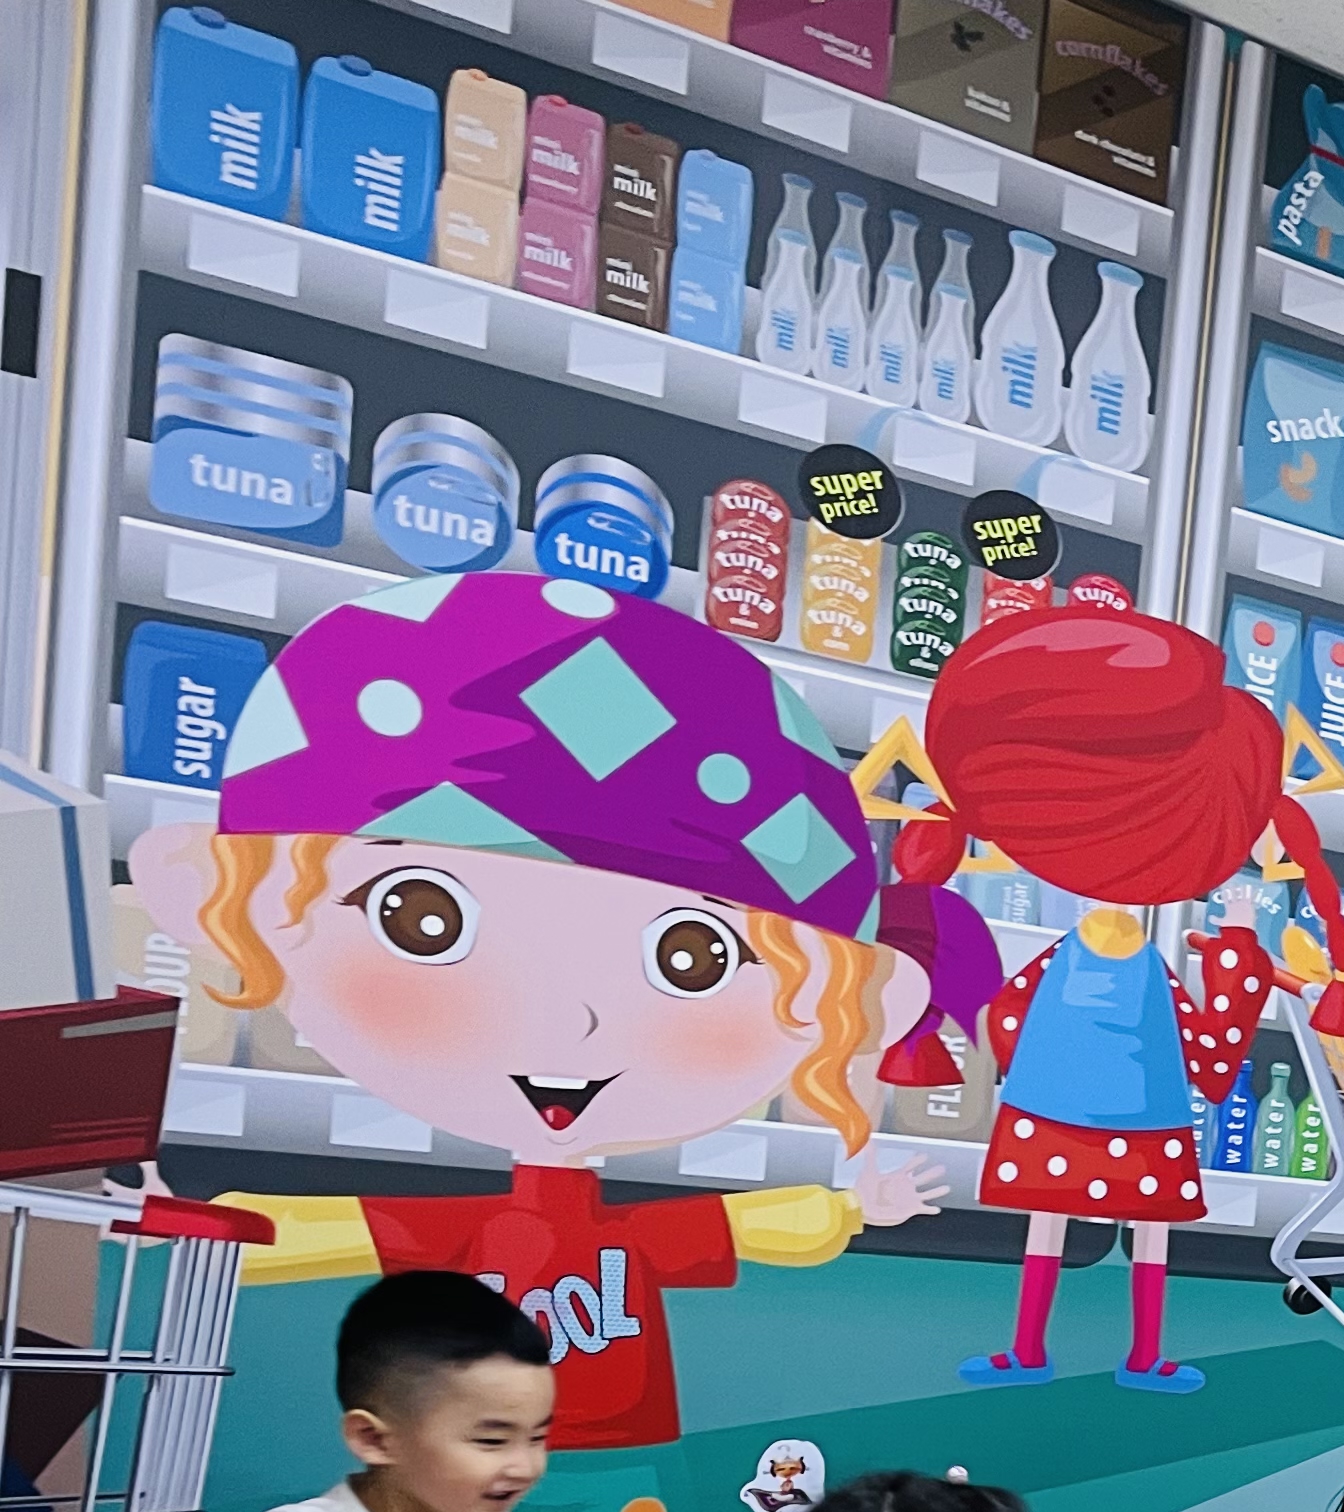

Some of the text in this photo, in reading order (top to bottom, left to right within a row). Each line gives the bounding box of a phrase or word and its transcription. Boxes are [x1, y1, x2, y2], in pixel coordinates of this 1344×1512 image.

[209, 103, 263, 191] milk
[354, 147, 405, 232] milk
[613, 176, 657, 201] milk
[1277, 170, 1325, 246] pasta
[606, 269, 650, 294] milk
[1001, 340, 1038, 409] milk
[1090, 369, 1124, 436] milk
[1266, 407, 1344, 443] snack
[189, 454, 294, 506] tuna
[809, 470, 884, 500] super
[393, 494, 496, 548] tuna
[719, 493, 784, 523] tuna
[819, 493, 879, 524] price!
[973, 515, 1042, 543] super
[553, 532, 652, 583] tuna
[715, 551, 779, 580] tuna
[903, 541, 962, 570] tuna
[981, 537, 1038, 567] price!
[712, 586, 777, 614] tuna
[809, 575, 870, 602] tuna
[1073, 586, 1128, 611] tuna
[807, 609, 867, 636] tuna
[899, 596, 957, 624] tuna
[896, 630, 955, 657] tuna
[174, 676, 230, 779] sugar
[1226, 1093, 1247, 1164] water
[1264, 1098, 1285, 1169] water
[1301, 1103, 1321, 1172] water
